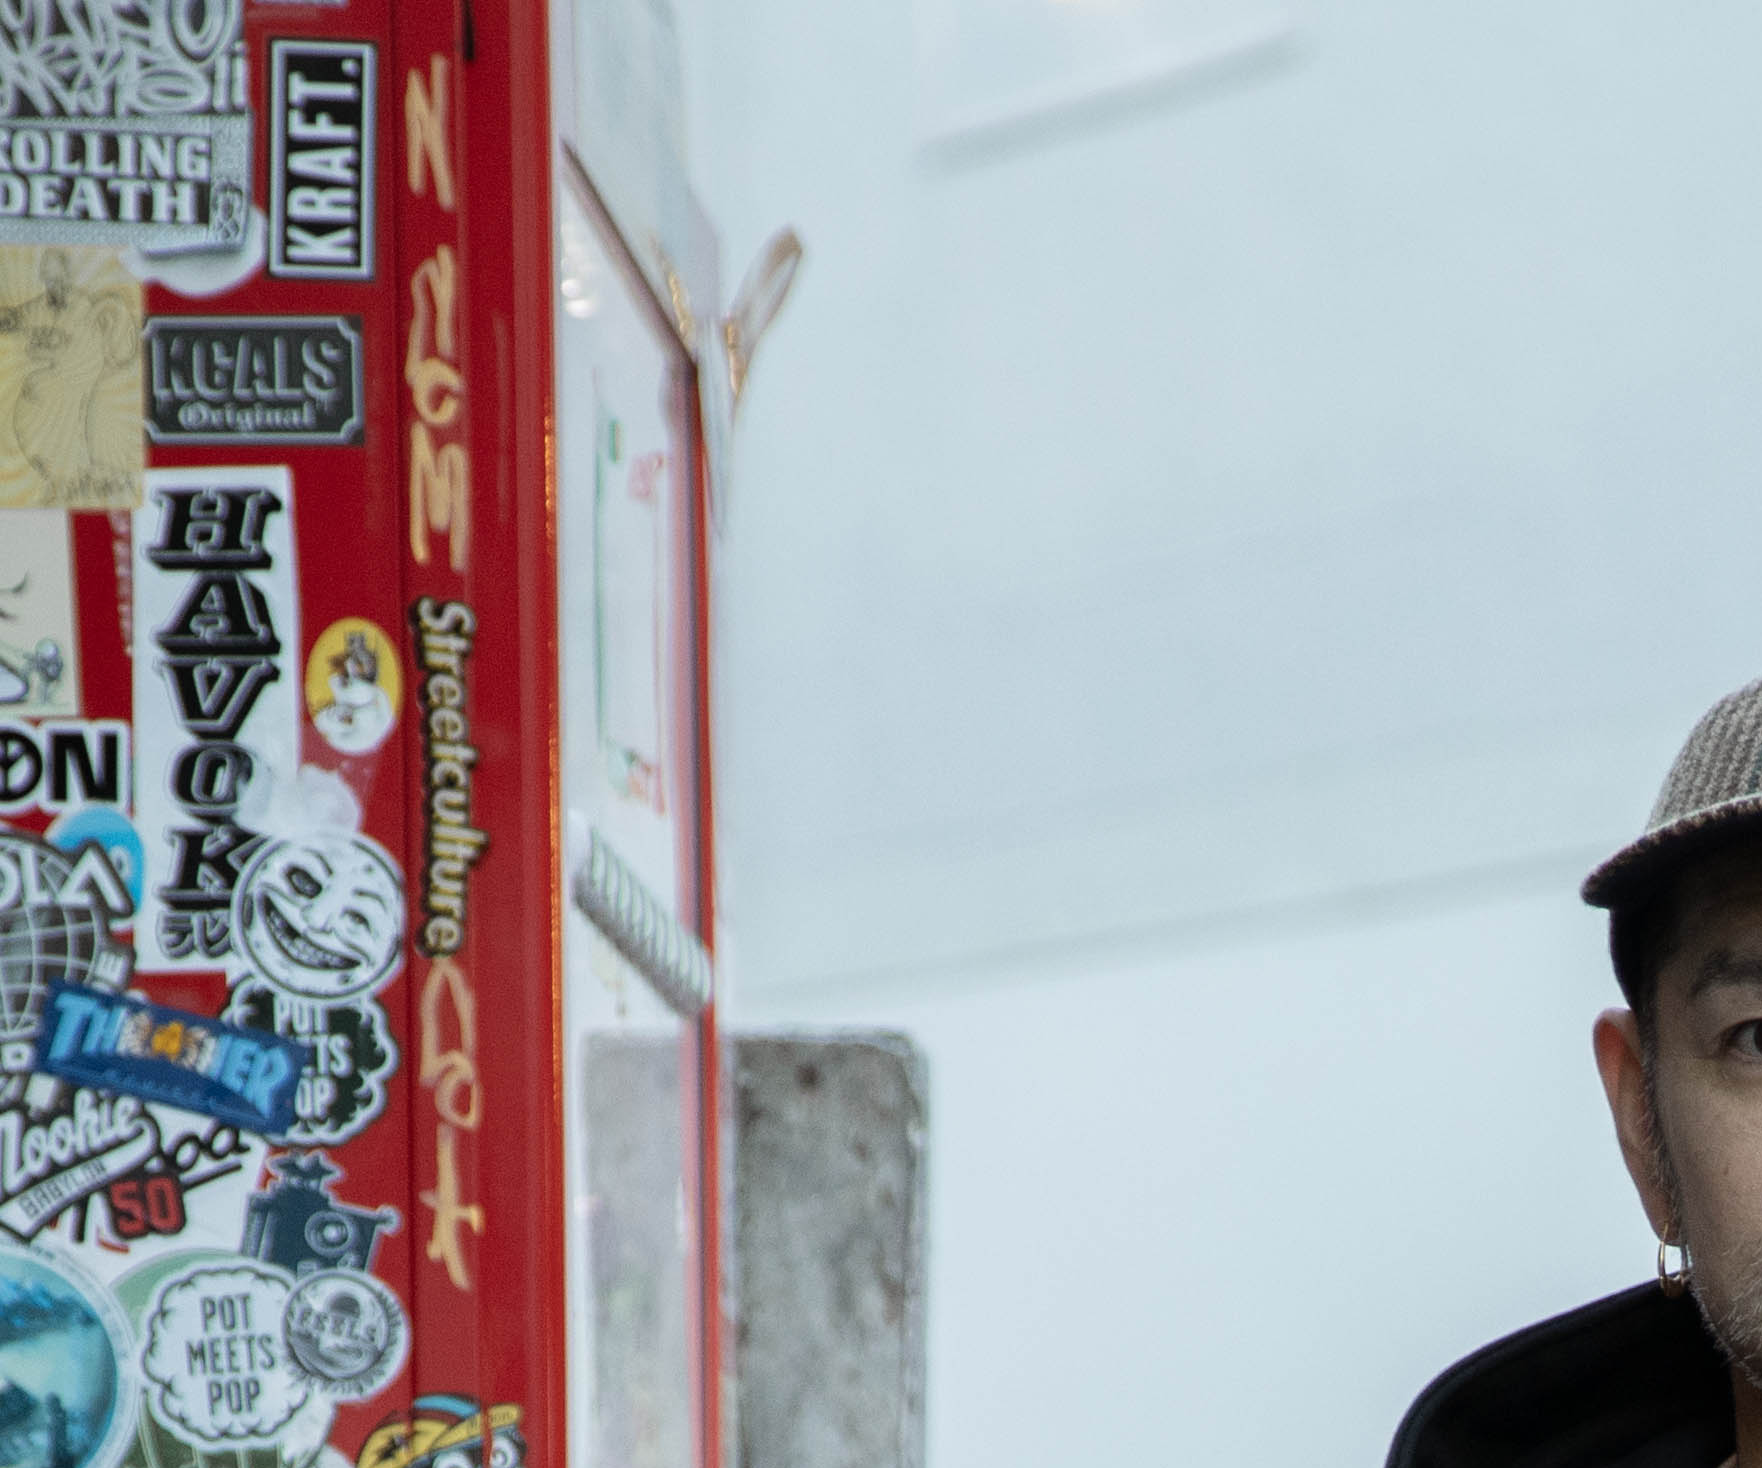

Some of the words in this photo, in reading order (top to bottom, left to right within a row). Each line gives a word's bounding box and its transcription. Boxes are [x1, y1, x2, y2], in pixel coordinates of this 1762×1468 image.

[286, 57, 360, 264] KRAFT.
[0, 173, 198, 222] DEATH
[177, 398, 317, 434] Original
[415, 597, 488, 957] Streetculture
[294, 1076, 337, 1119] OP
[110, 1176, 183, 1237] 50
[200, 1292, 251, 1332] POT
[185, 1334, 275, 1377] MEETS
[207, 1378, 261, 1417] POP
